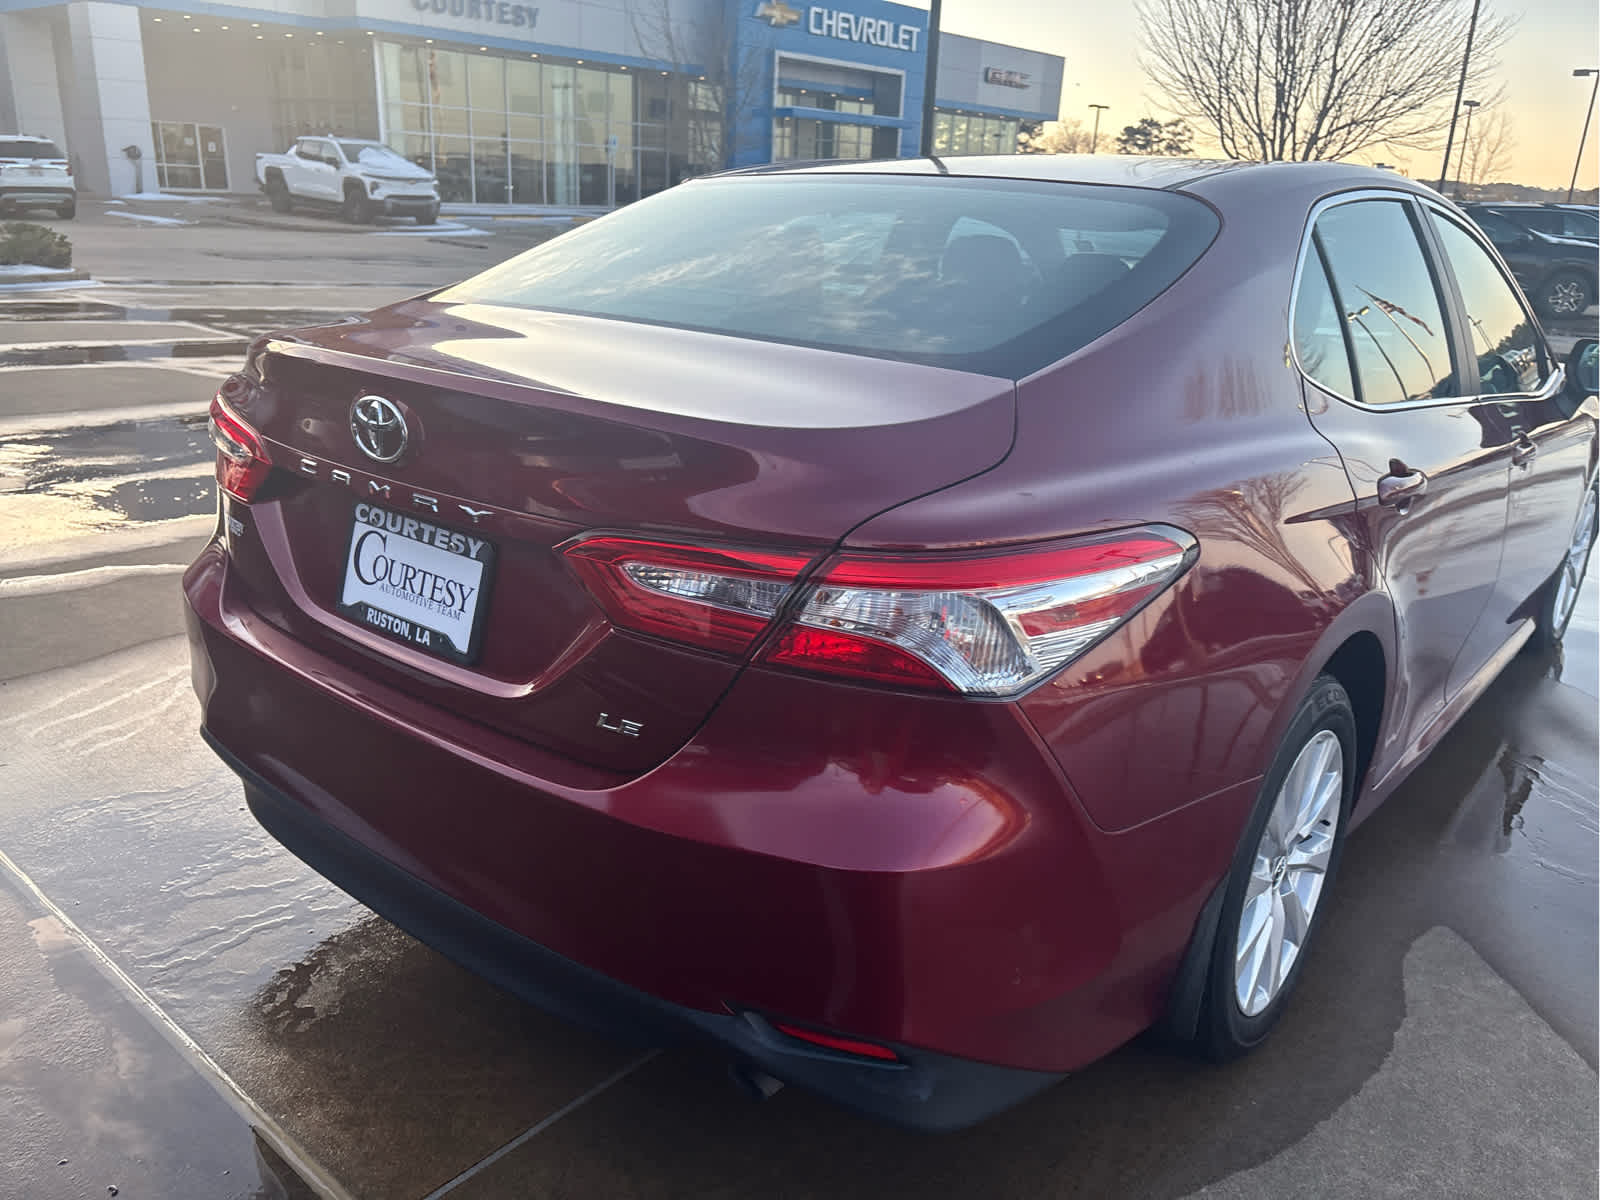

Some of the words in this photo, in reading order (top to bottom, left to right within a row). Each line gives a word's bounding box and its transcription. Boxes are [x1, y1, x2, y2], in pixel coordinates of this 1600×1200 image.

[411, 0, 540, 29] COURTESY
[808, 6, 921, 52] CHEVROLET
[300, 457, 495, 523] CAMRY
[355, 503, 484, 559] COURTESY
[380, 583, 434, 610] AUTOMOTIVE
[436, 604, 463, 621] TEAM
[366, 607, 412, 640] RUSTON,
[415, 627, 431, 646] LA
[596, 712, 643, 736] LE
